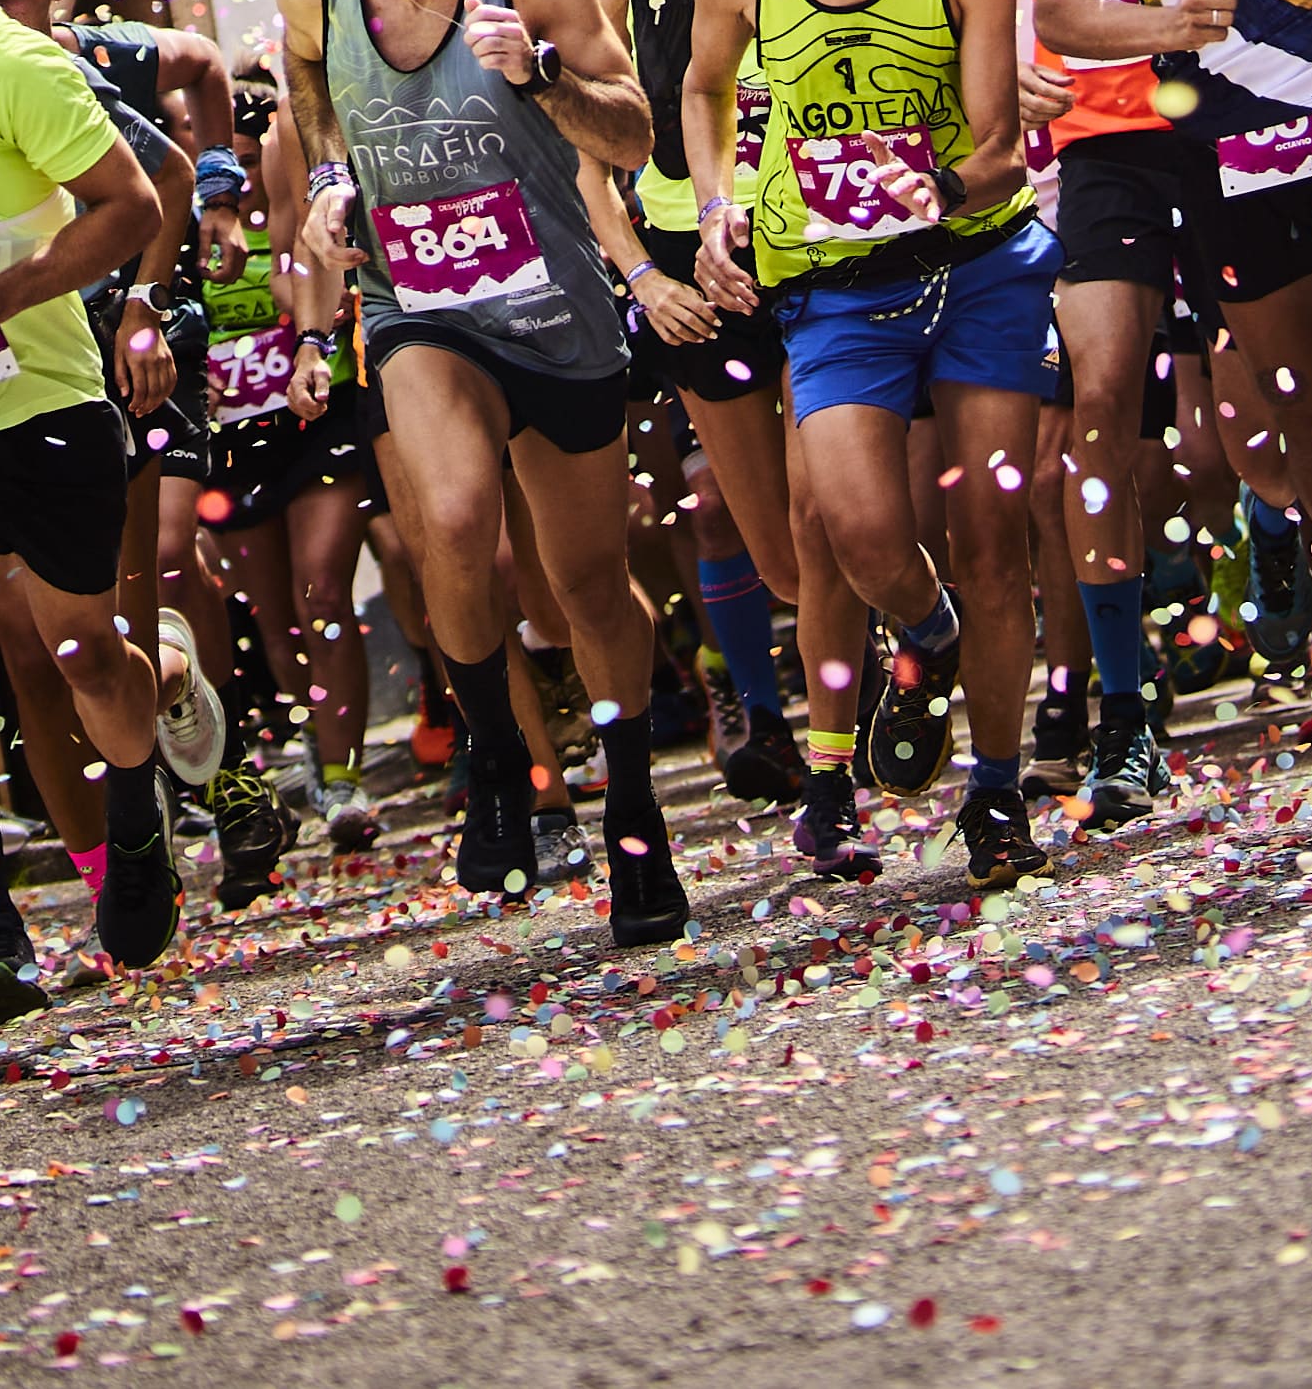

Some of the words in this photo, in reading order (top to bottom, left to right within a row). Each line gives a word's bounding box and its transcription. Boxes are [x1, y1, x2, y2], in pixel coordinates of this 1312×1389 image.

[353, 129, 506, 170] DESAFÍO
[1275, 137, 1312, 152] OCTAVIO
[388, 158, 480, 186] URBIÓN
[858, 199, 881, 208] IVAN
[409, 215, 509, 266] 864
[453, 258, 480, 271] HUGO
[220, 345, 291, 390] 756
